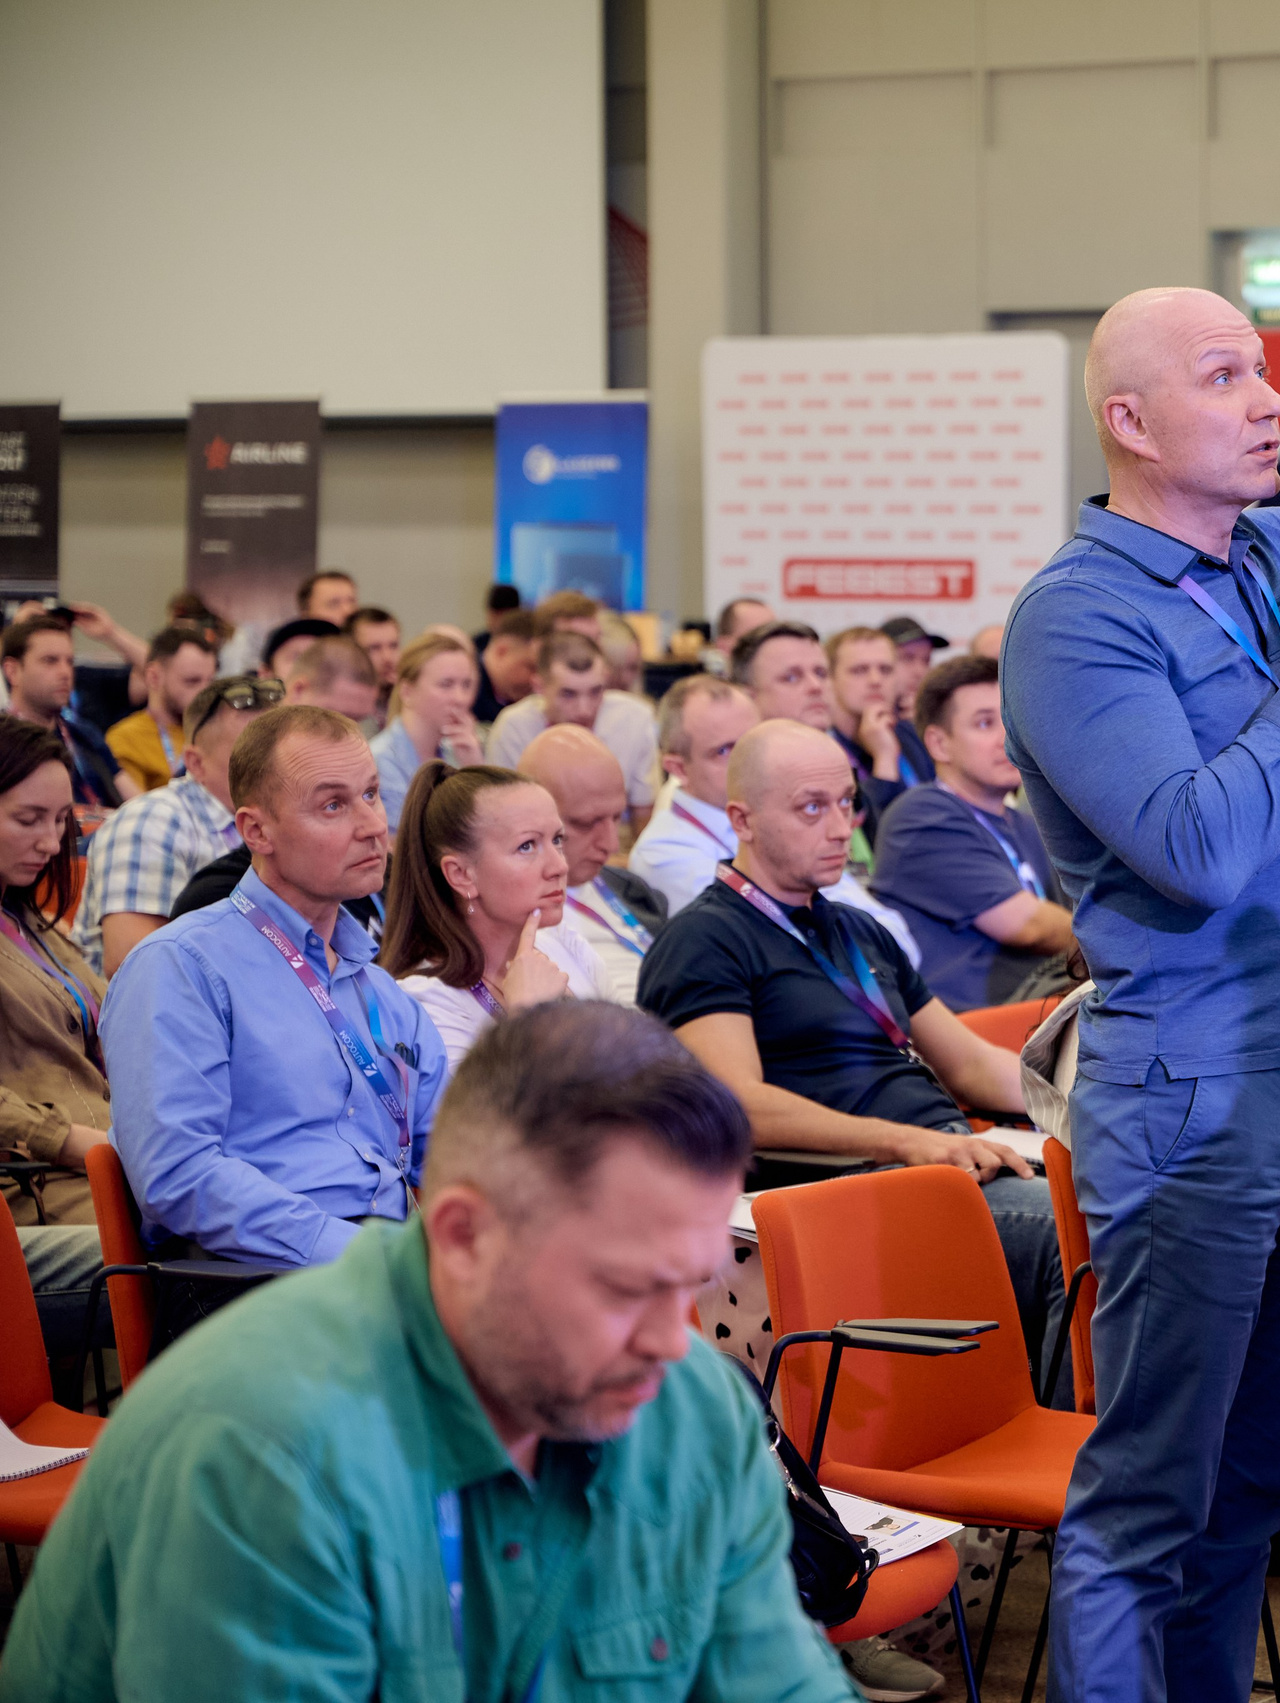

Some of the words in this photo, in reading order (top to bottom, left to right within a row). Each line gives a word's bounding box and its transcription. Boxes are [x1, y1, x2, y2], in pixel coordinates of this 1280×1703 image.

[229, 441, 308, 465] AIRLINE
[261, 925, 292, 957] AUTOCOM
[339, 1030, 366, 1065] AUTOCOM
